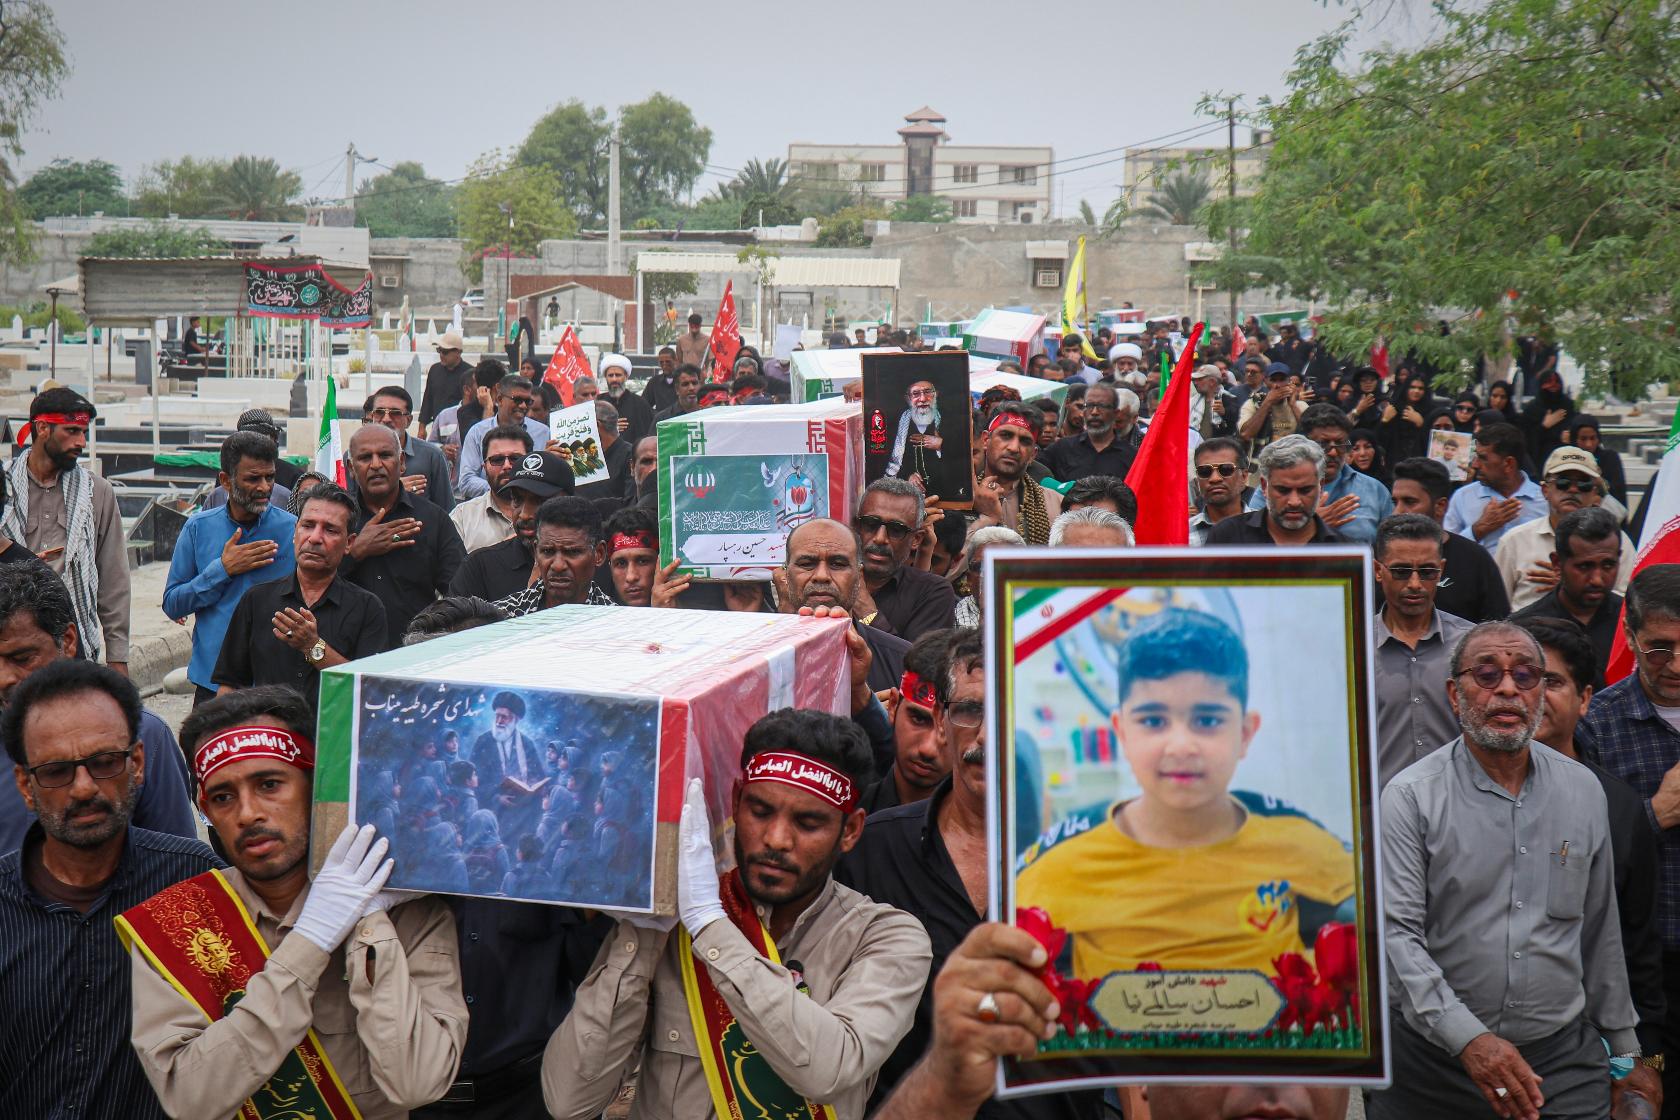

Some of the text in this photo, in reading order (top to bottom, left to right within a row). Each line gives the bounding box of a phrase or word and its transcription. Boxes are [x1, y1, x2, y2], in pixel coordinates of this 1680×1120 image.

[742, 537, 767, 558] حسین
[364, 683, 486, 724] شهدای شجره طیبه میناب
[278, 737, 288, 754] یا
[200, 740, 228, 771] العباس
[754, 758, 793, 774] العباس
[835, 781, 843, 798] یا
[1168, 975, 1197, 988] دانش
[1199, 976, 1228, 987] شهید
[1122, 989, 1143, 1014] نیا
[1191, 988, 1260, 1014] احسان
